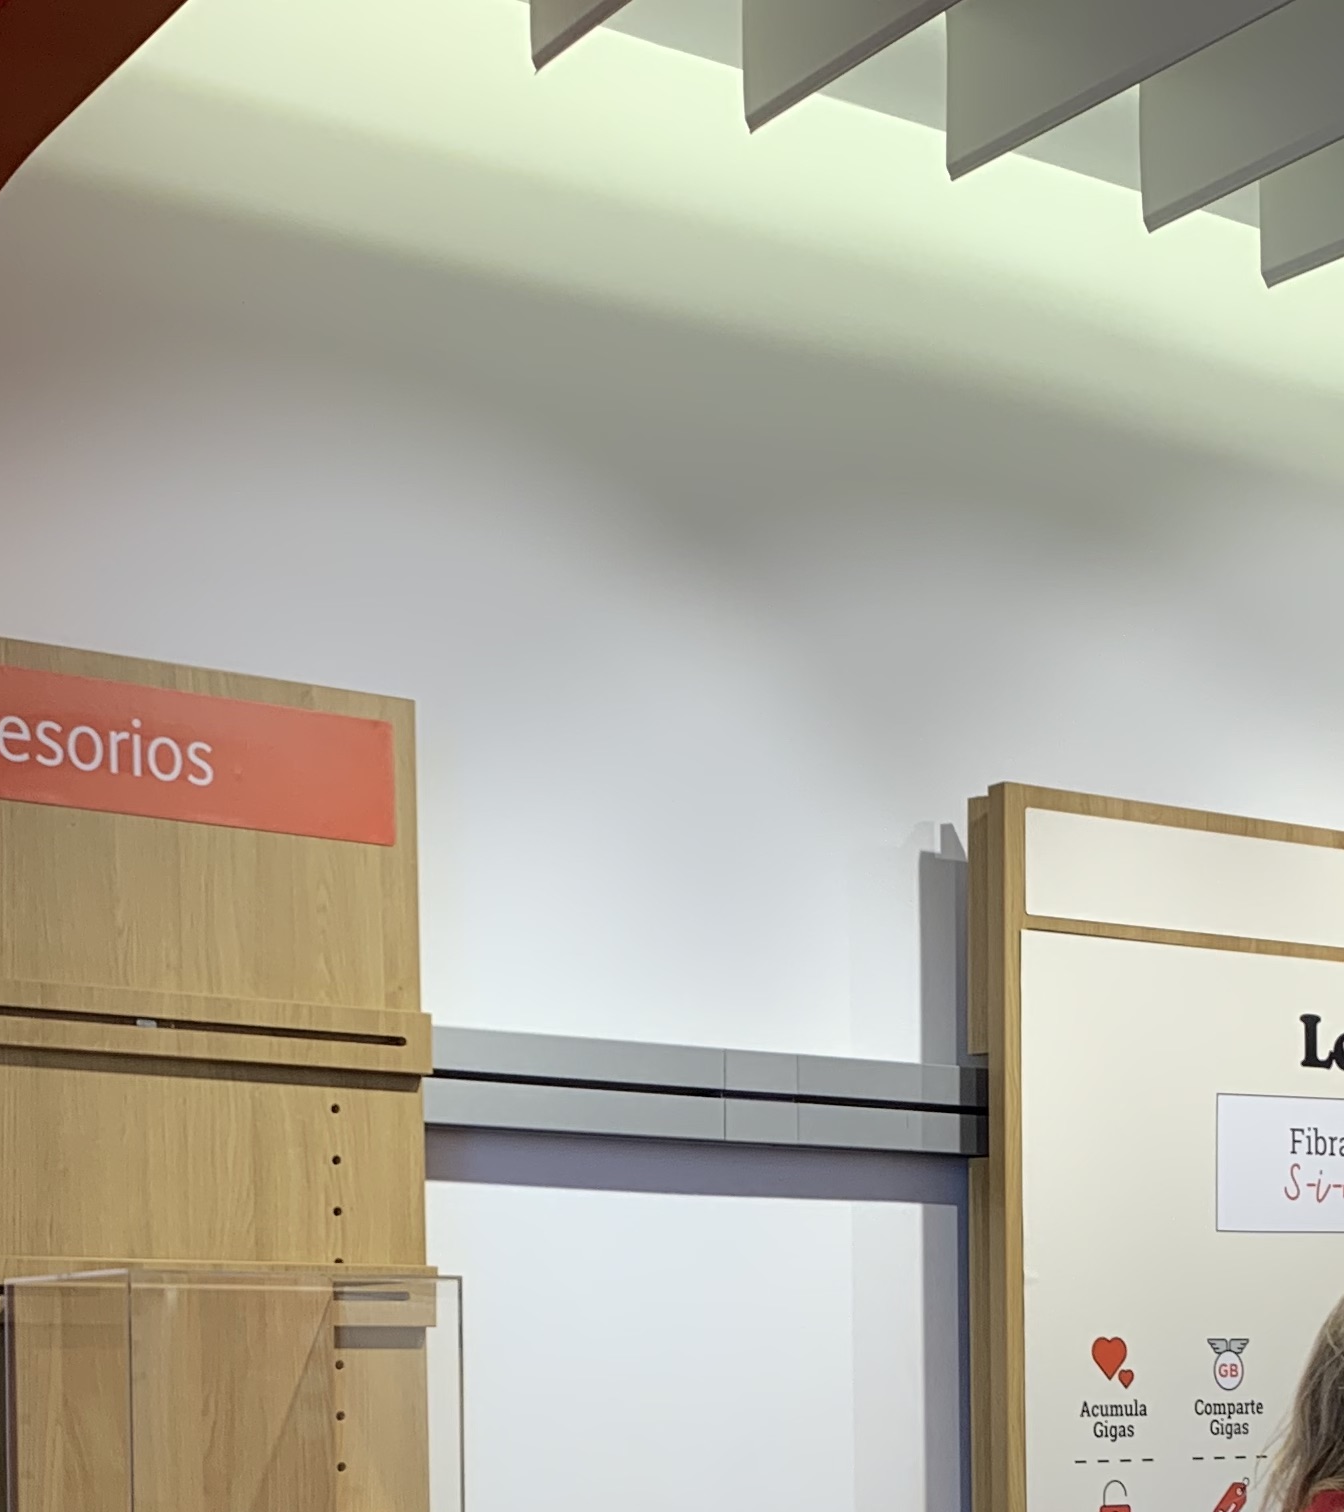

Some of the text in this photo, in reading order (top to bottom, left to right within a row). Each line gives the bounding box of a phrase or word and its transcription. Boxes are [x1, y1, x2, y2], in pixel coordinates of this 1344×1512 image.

[1218, 1363, 1239, 1378] GB
[1080, 1399, 1147, 1417] Acumula
[1194, 1399, 1264, 1419] Comparte
[1093, 1421, 1135, 1441] Gigas
[1209, 1419, 1250, 1439] Gigas
